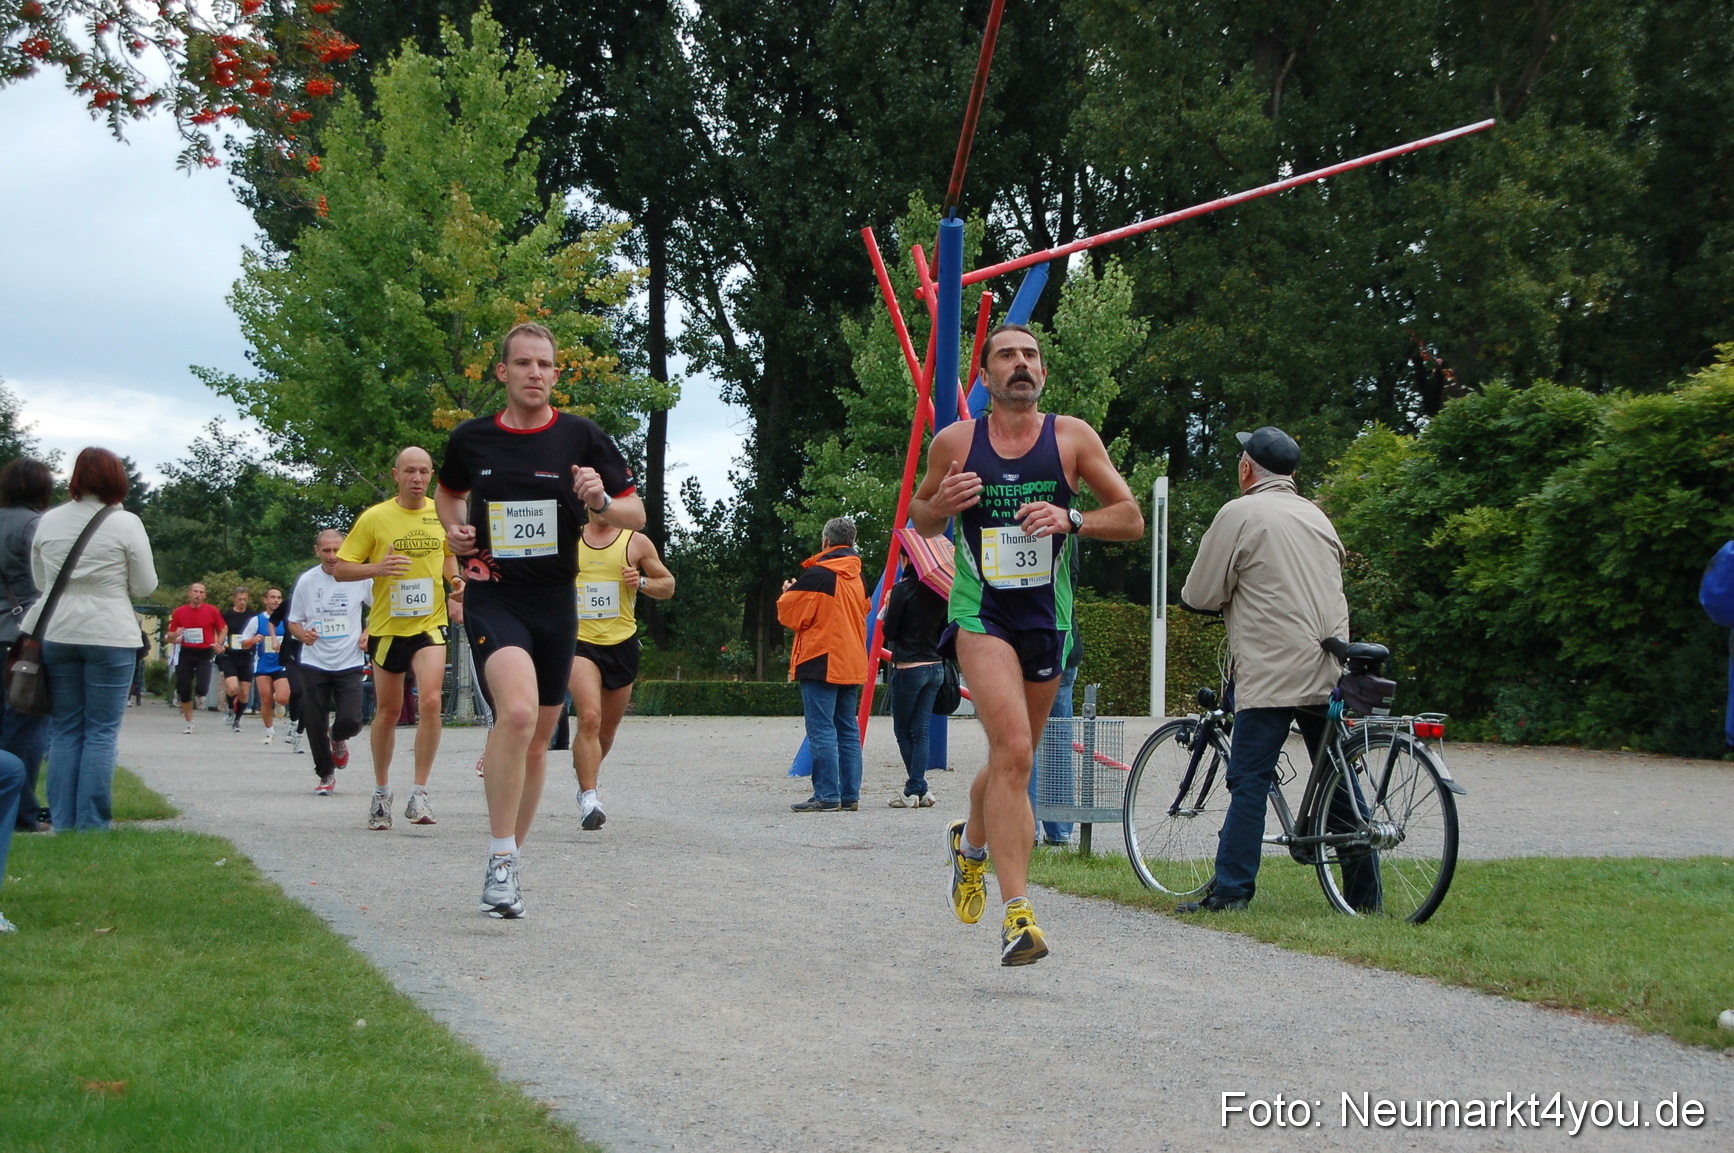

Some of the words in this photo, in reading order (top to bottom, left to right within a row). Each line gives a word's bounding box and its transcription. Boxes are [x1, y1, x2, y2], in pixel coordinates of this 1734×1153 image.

[986, 481, 1057, 497] INTERSPORT
[506, 506, 544, 518] Matthias
[514, 522, 546, 539] 204
[1000, 533, 1037, 545] Thomas
[1015, 550, 1038, 568] 33
[400, 583, 421, 591] Harald
[406, 592, 427, 605] 640
[591, 596, 612, 607] 561
[324, 623, 346, 633] 3171
